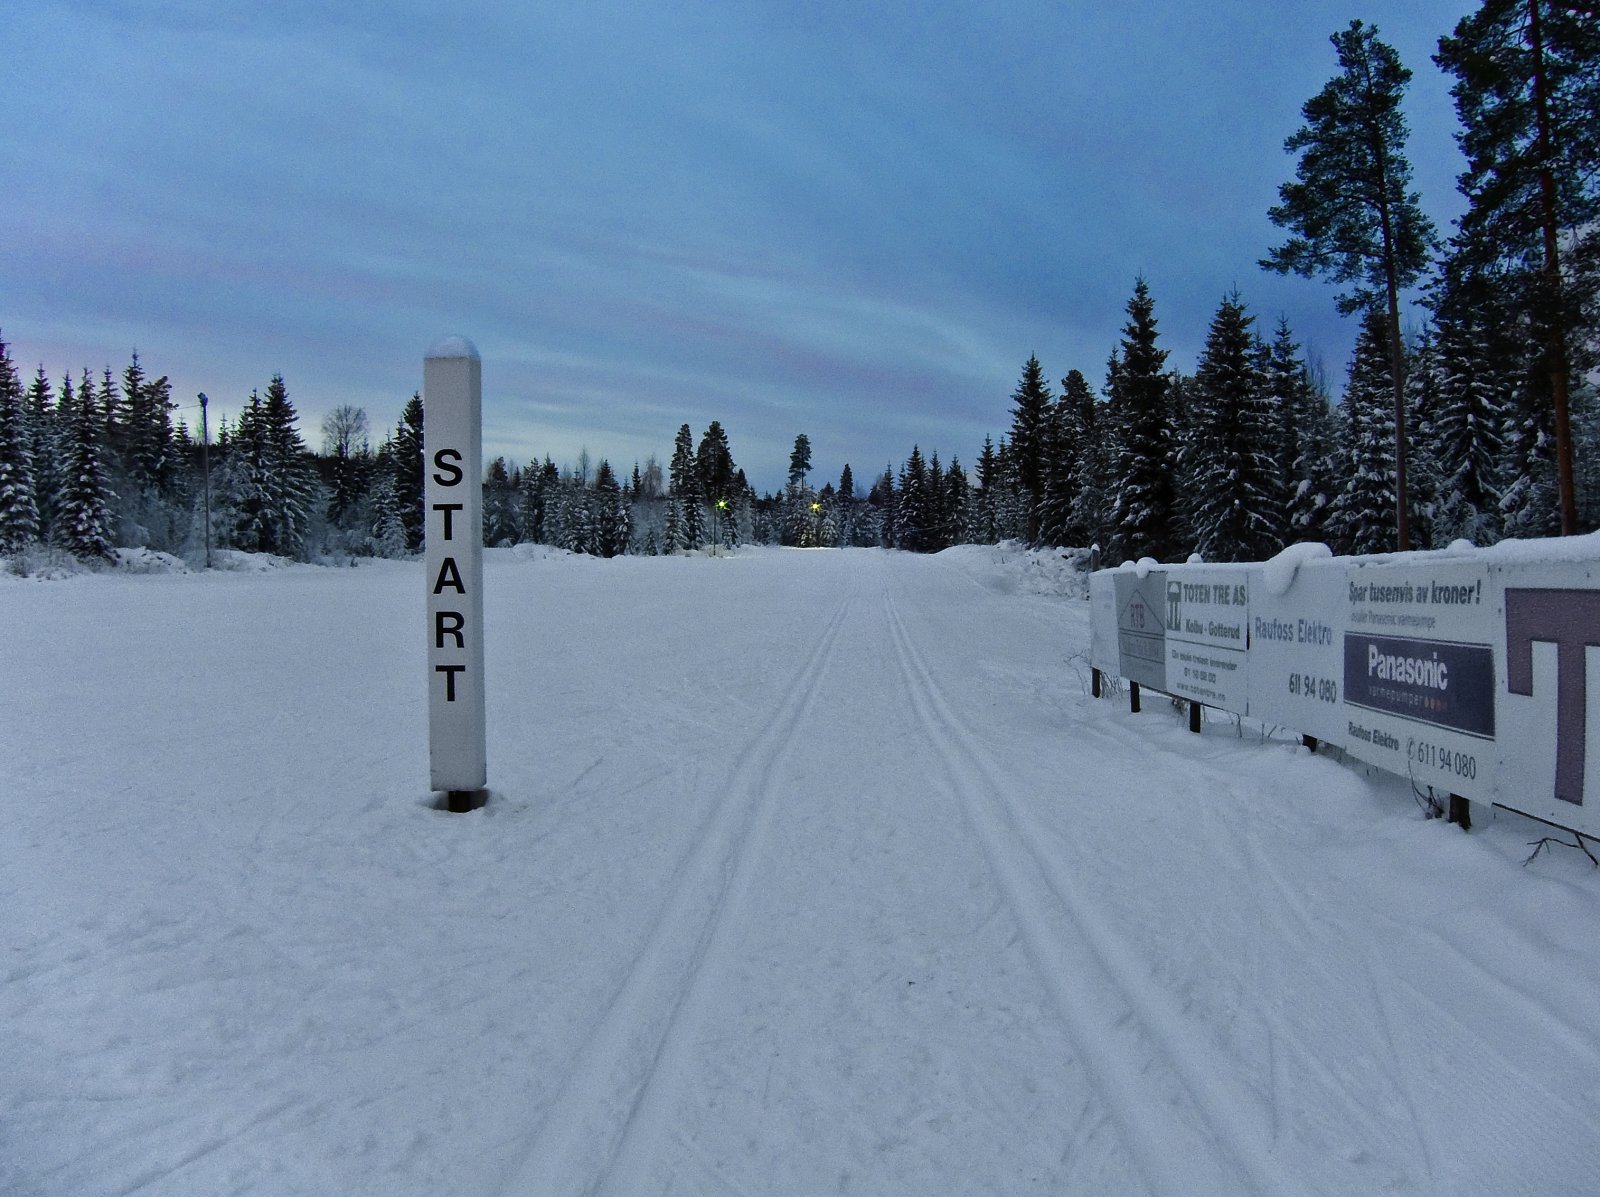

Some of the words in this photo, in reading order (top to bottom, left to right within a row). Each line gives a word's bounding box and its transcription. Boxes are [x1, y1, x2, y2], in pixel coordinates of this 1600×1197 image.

[432, 448, 466, 702] START
[1183, 583, 1210, 604] TOTEN
[1213, 585, 1230, 605] TRE
[1232, 585, 1246, 606] AS
[1349, 581, 1367, 605] Spar
[1370, 581, 1413, 604] tusenvis
[1416, 588, 1428, 604] av
[1431, 579, 1481, 605] kroner!
[1255, 617, 1294, 642] Raufoss
[1298, 619, 1332, 646] Elektro
[1368, 644, 1448, 691] Panasonic
[1289, 673, 1301, 695] 611
[1304, 675, 1316, 699] 94
[1319, 678, 1337, 703] 080
[1372, 729, 1399, 751] Elektro
[1418, 742, 1436, 767] 611
[1439, 747, 1451, 772] 94
[1454, 752, 1476, 780] 080
